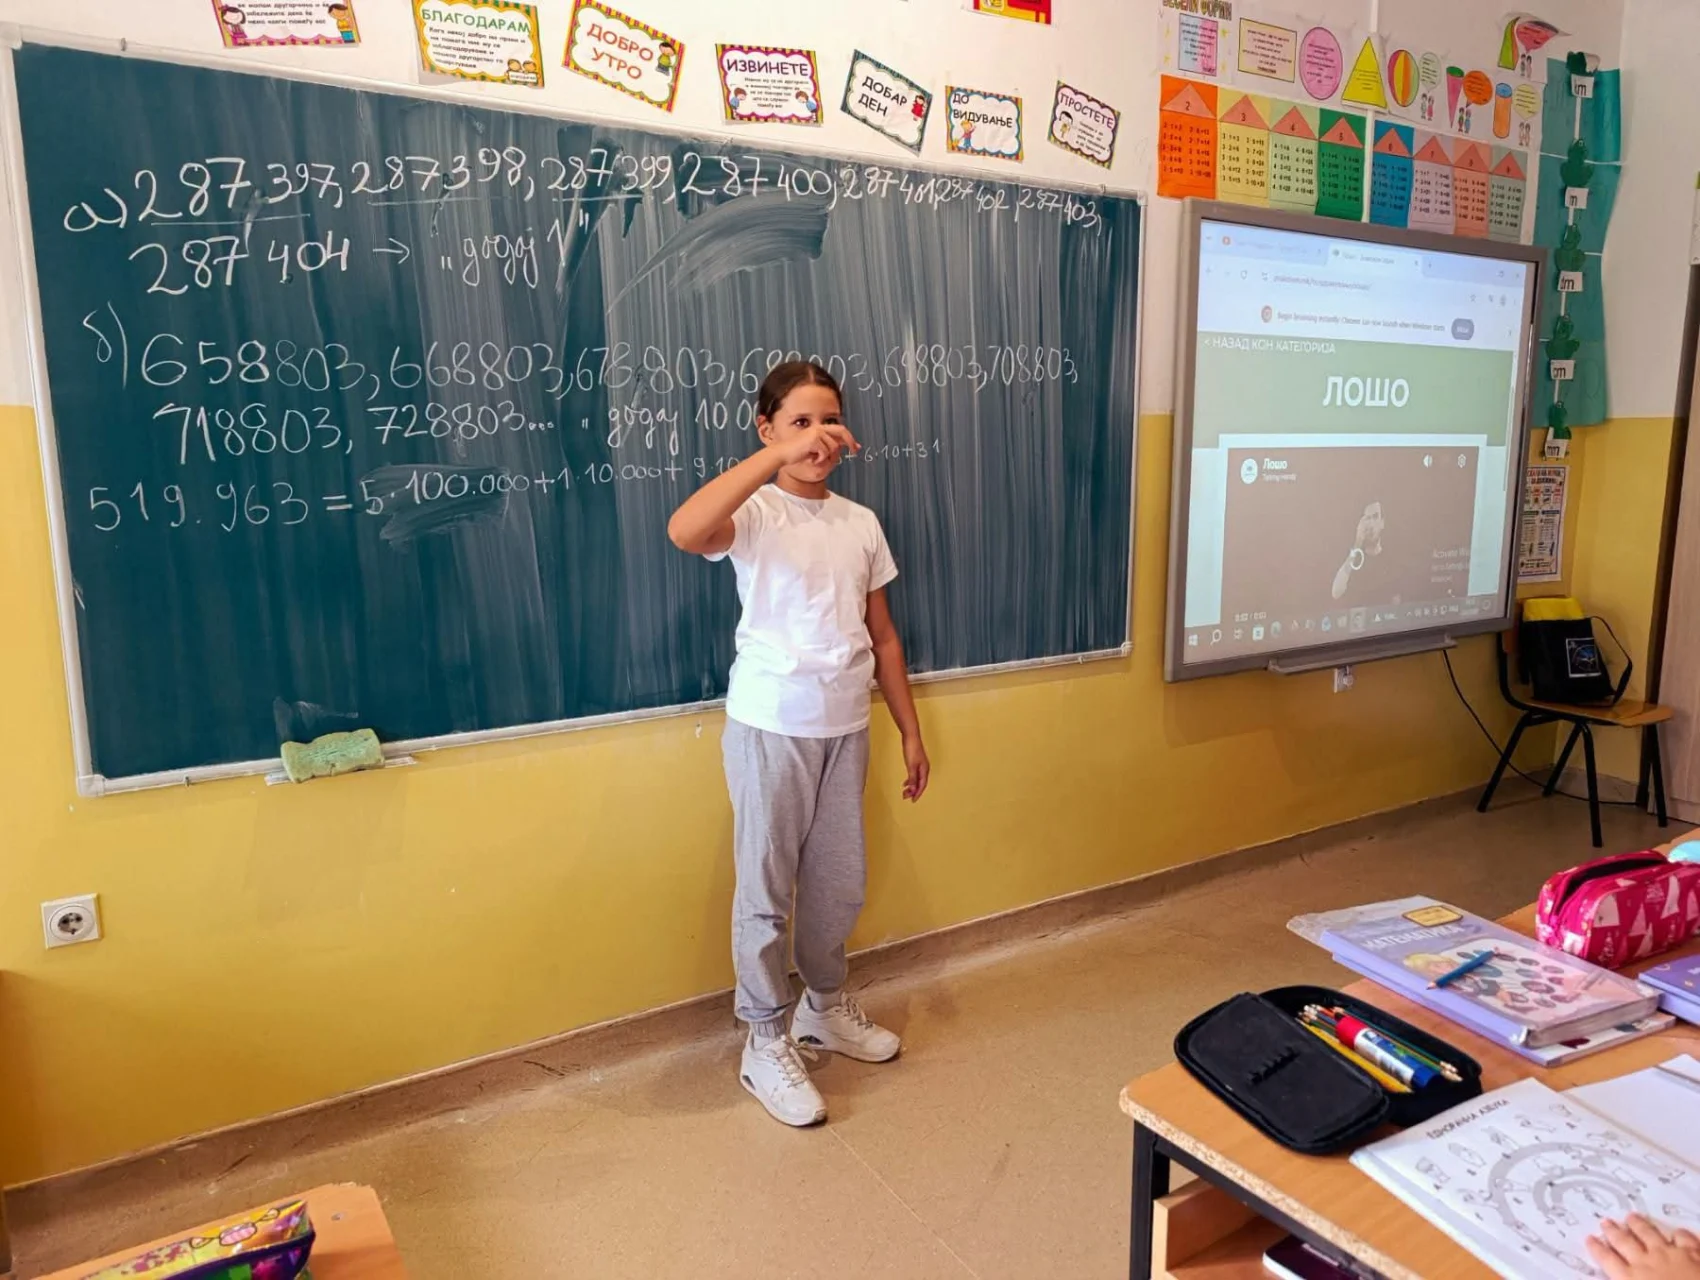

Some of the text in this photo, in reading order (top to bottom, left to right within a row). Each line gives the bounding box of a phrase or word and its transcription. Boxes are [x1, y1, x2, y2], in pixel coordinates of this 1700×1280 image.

[421, 8, 531, 33] БЛАГОДАРАМ
[587, 22, 654, 62] ДОБРО
[592, 47, 642, 80] УТРО
[726, 58, 809, 77] ИЗВИНЕТЕ
[861, 75, 908, 107] ДОБАР
[952, 92, 970, 105] ДО
[857, 93, 889, 117] ДЕН
[1059, 92, 1114, 130] ПРОСТЕТЕ
[1185, 101, 1191, 111] 2
[1241, 112, 1247, 122] 3
[953, 108, 1013, 128] ВИДУВАЊЕ
[1213, 337, 1336, 354] НАЗАД КОН КАТЕГОРИЈА
[1322, 376, 1410, 408] ЛОШО
[152, 402, 353, 465] 718803,
[1262, 458, 1288, 470] Лошо
